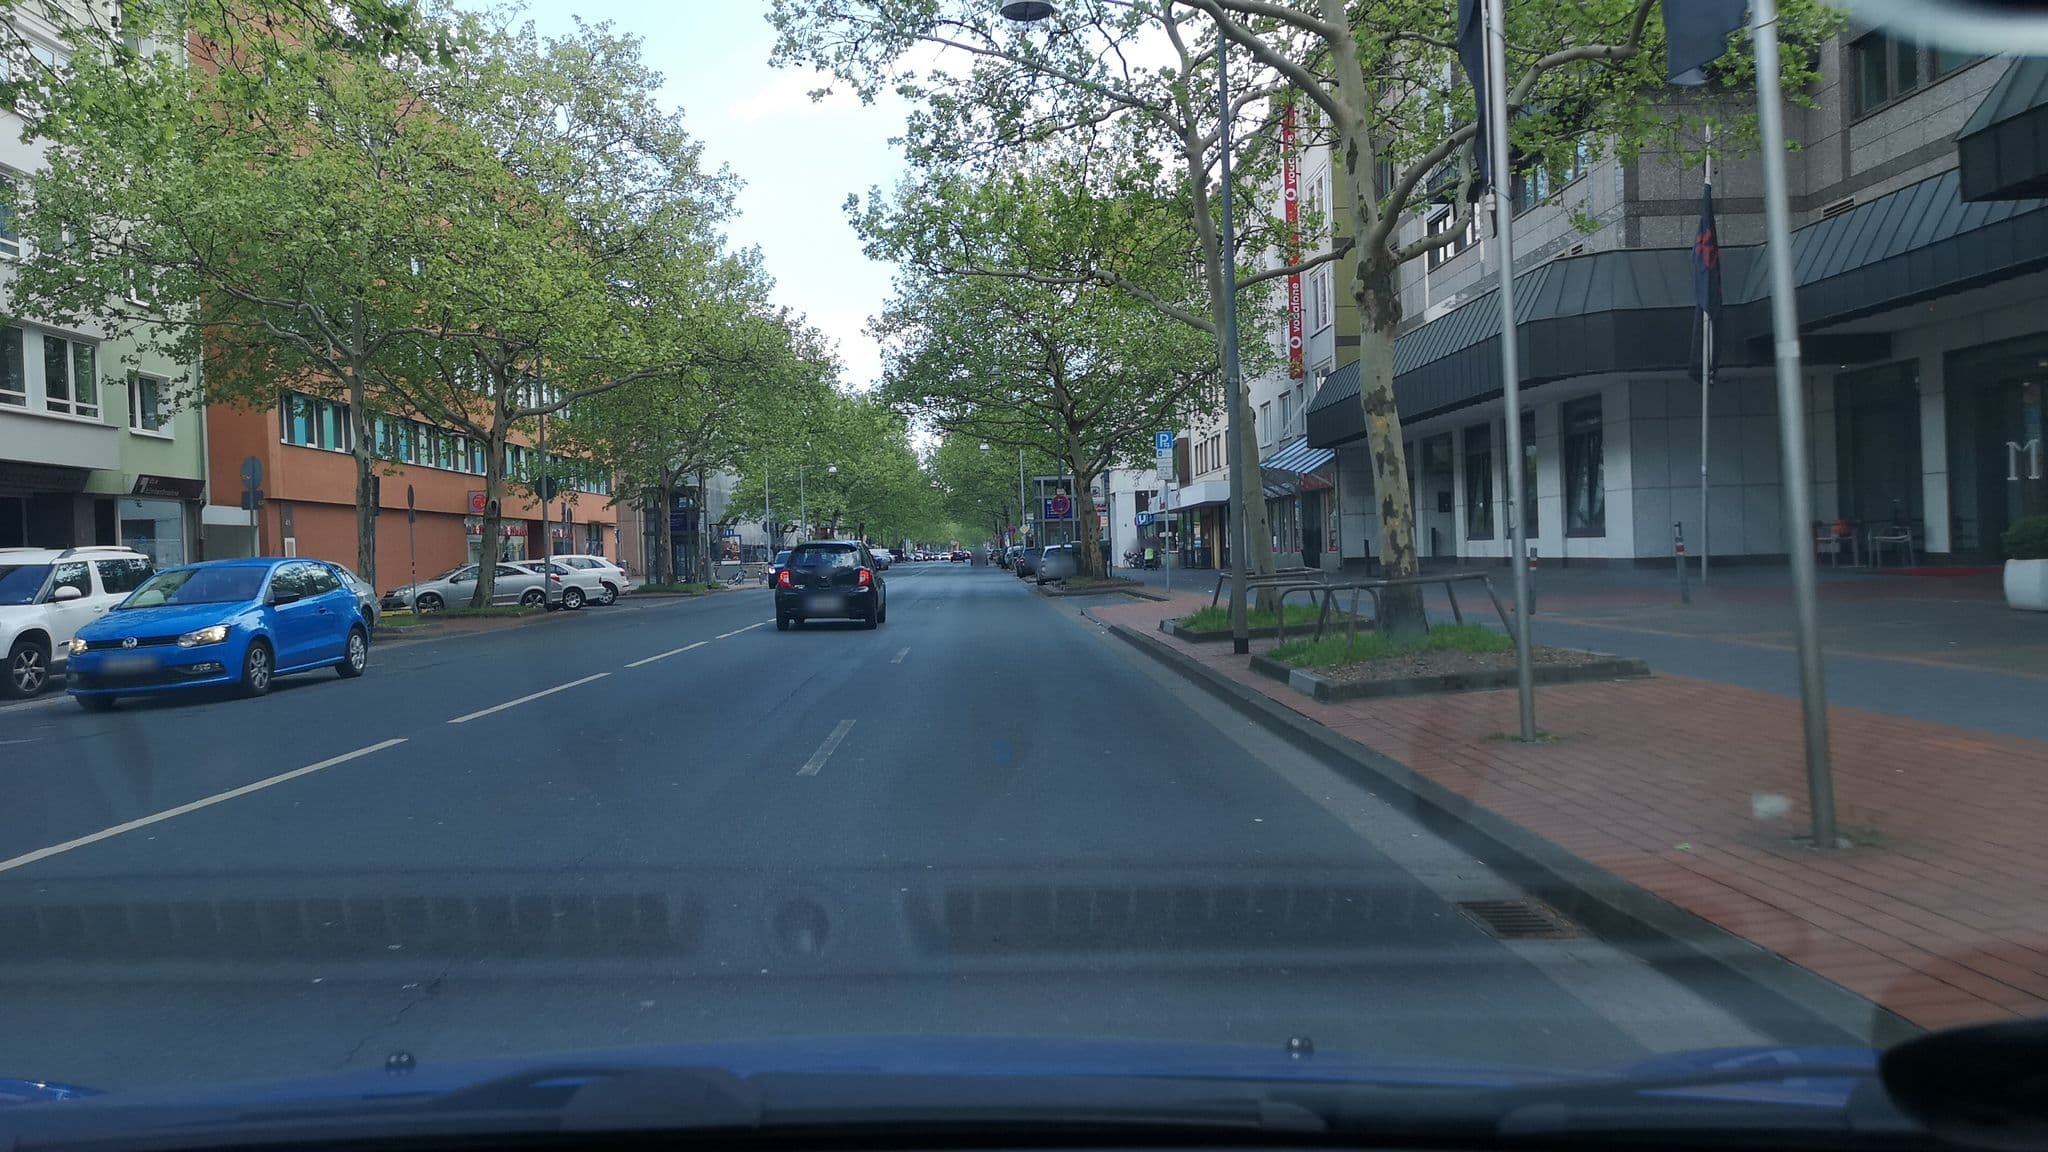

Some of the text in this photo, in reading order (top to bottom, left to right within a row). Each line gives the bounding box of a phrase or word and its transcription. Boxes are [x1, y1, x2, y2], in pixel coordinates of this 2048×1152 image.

[1290, 282, 1301, 333] vodafone
[1159, 433, 1169, 448] P
[2006, 438, 2040, 481] M
